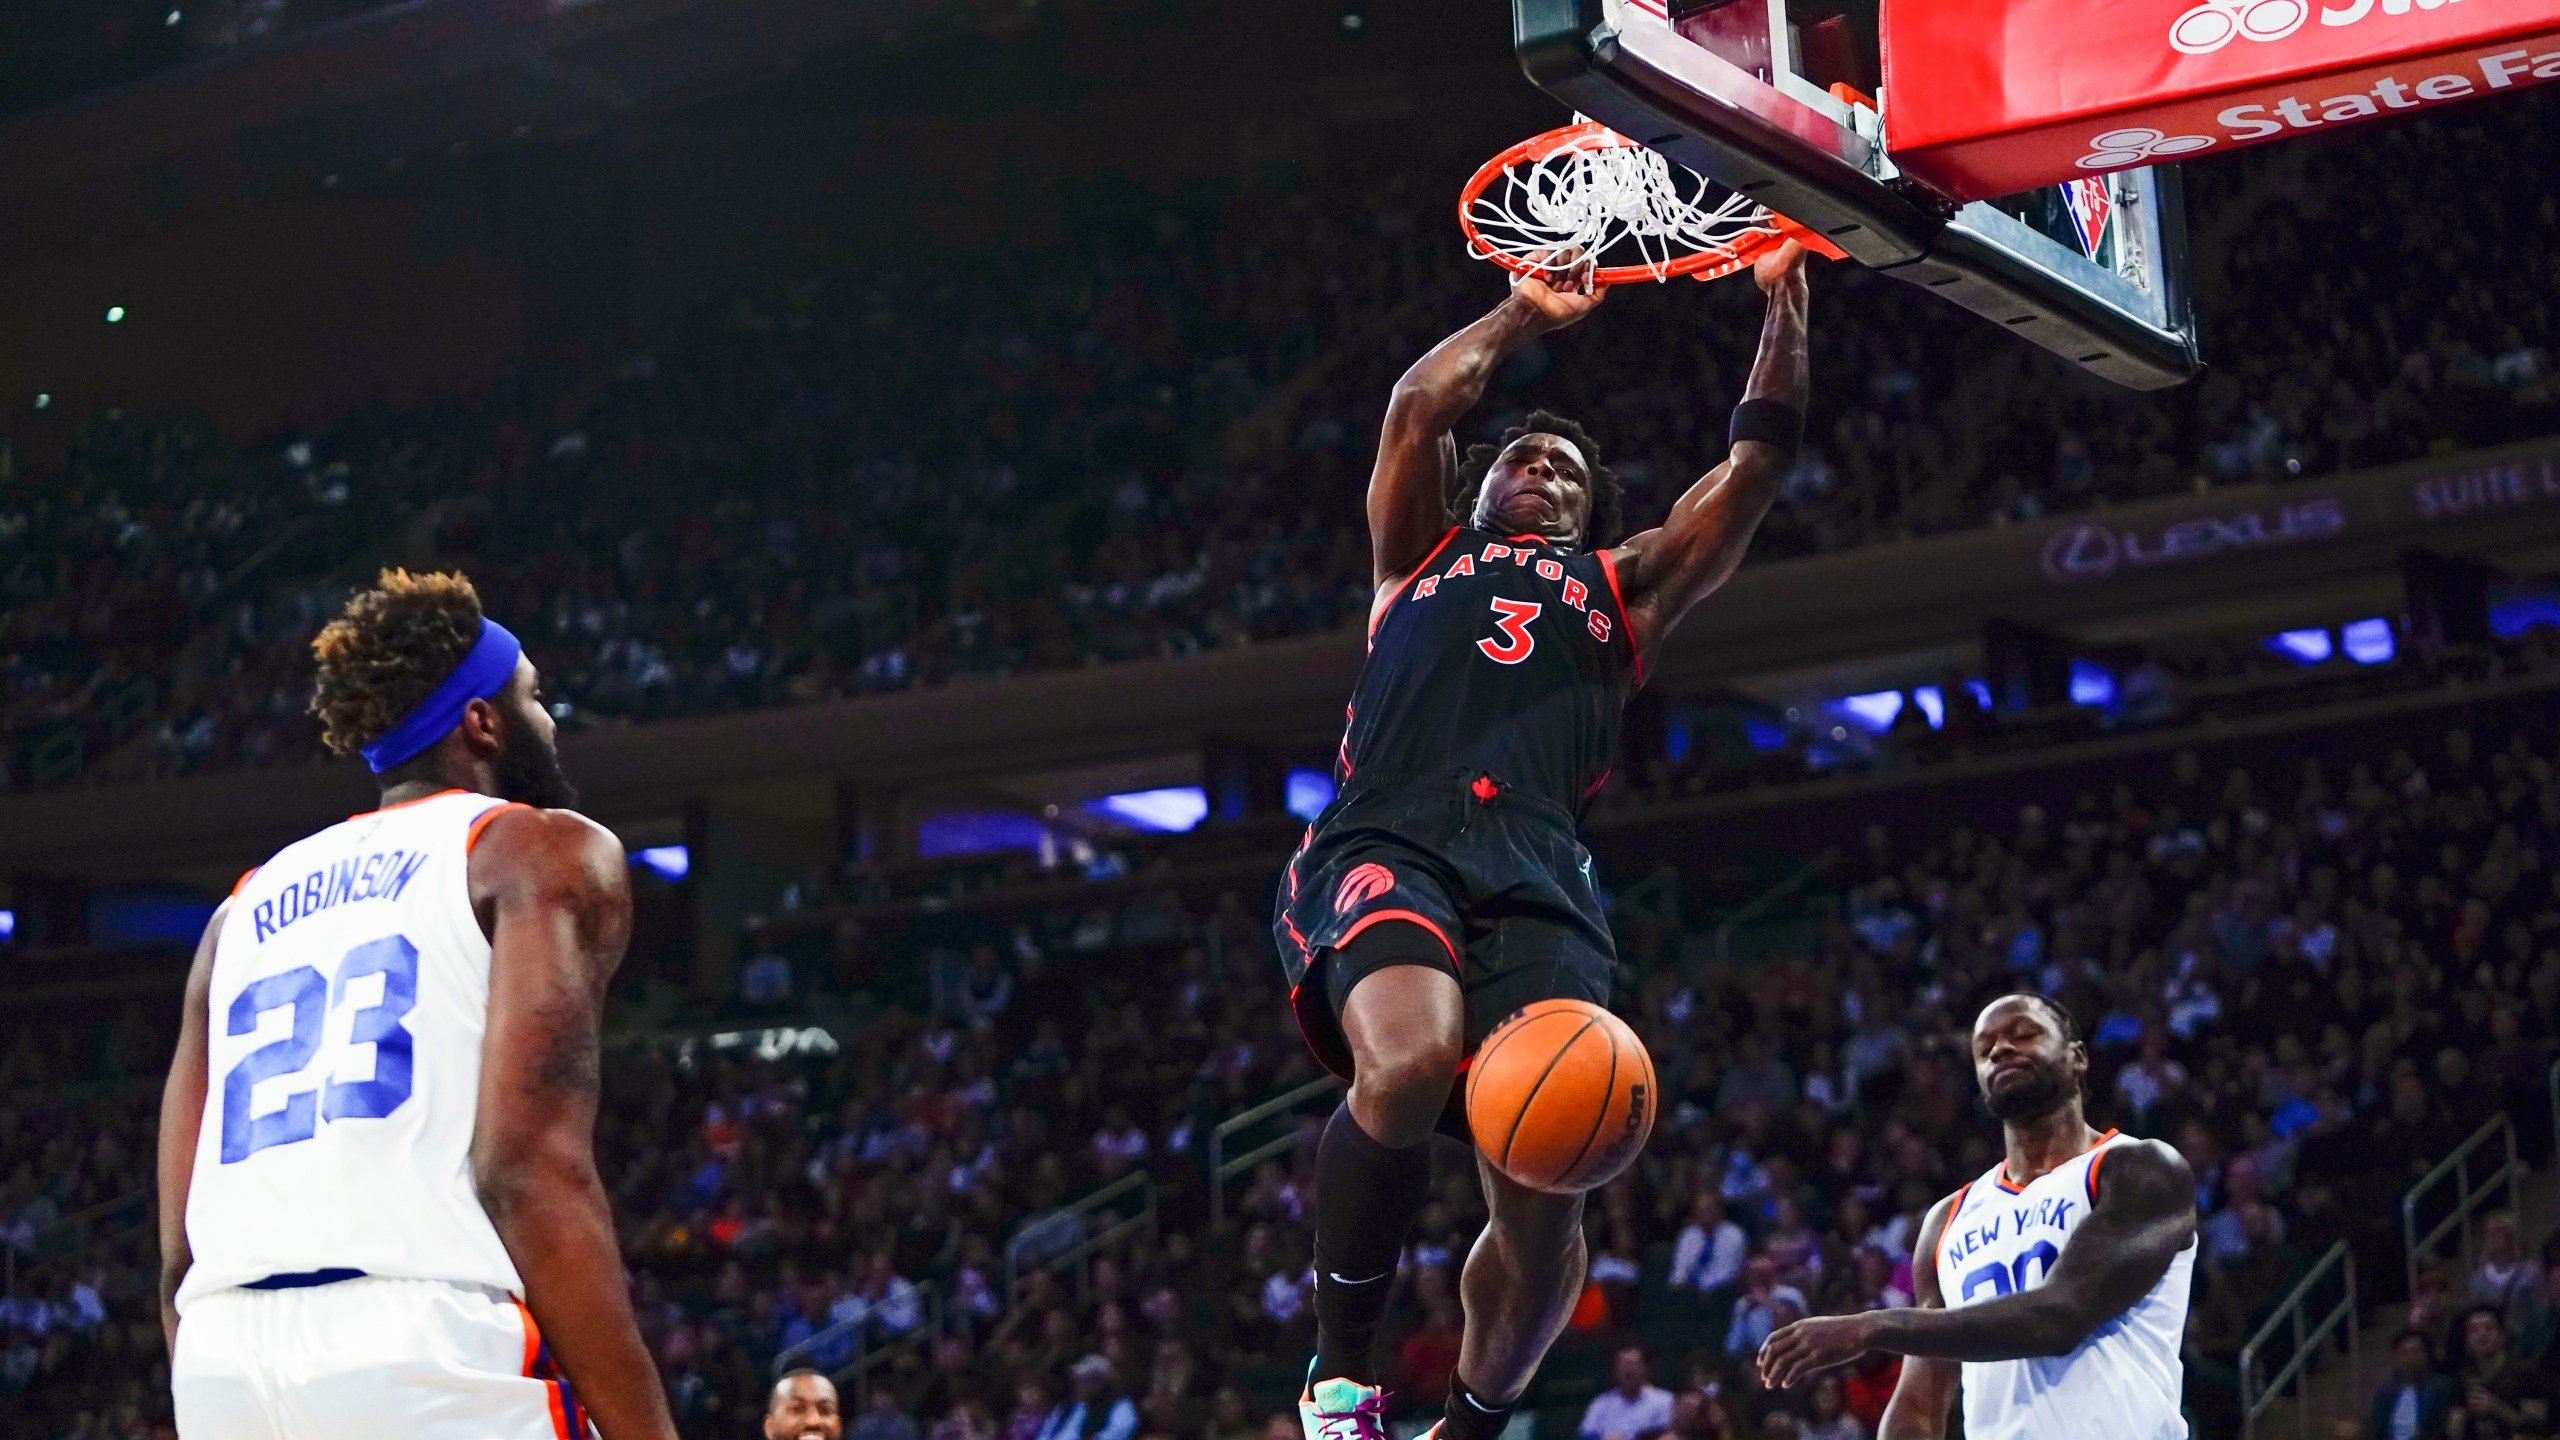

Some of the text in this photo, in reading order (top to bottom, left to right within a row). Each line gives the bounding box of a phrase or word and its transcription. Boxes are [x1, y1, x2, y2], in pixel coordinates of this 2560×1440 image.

[2216, 73, 2475, 141] State
[2121, 499, 2345, 563] LEXUS
[1411, 542, 1612, 643] RAPTORS
[1475, 595, 1543, 665] 3
[251, 849, 429, 944] ROBINSON
[220, 933, 419, 1165] 23
[1949, 1215, 2001, 1270] NEW
